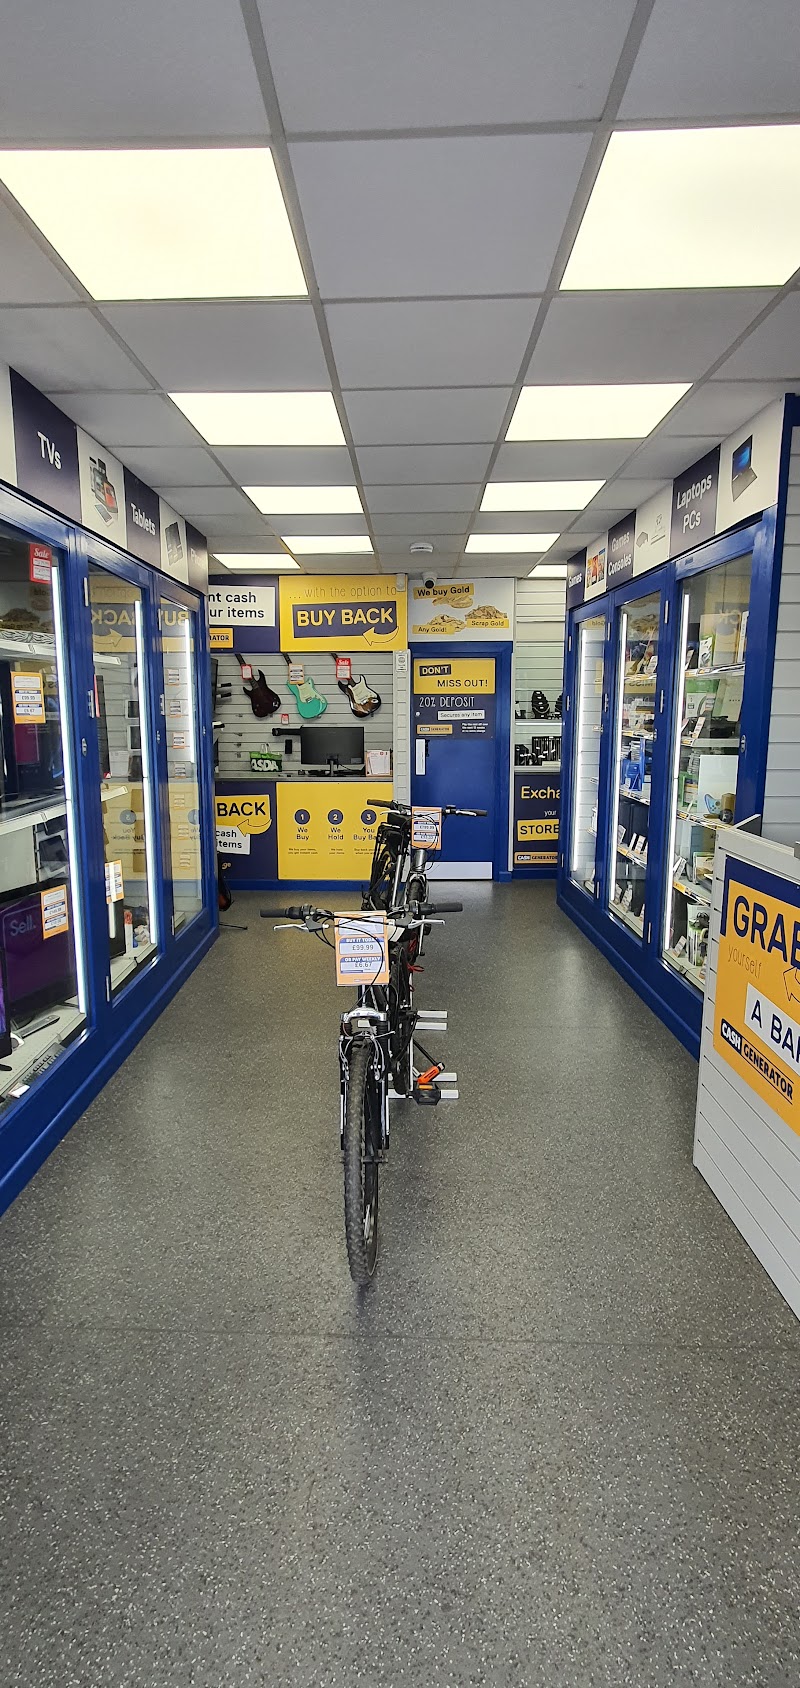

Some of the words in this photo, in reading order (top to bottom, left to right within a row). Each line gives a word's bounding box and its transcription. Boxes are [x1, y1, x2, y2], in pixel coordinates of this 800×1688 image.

[37, 431, 62, 470] TVs
[676, 474, 712, 510] Laptops
[130, 502, 156, 536] Tablets
[682, 509, 701, 534] PCs
[611, 531, 630, 552] Games
[33, 547, 50, 559] Sale
[607, 553, 632, 576] Consoles
[568, 572, 583, 588] Games
[225, 591, 257, 603] cash
[304, 587, 326, 598] with
[330, 586, 346, 597] the
[350, 585, 382, 599] option
[386, 586, 397, 596] to
[417, 589, 431, 597] We
[432, 588, 448, 597] buy
[450, 585, 470, 594] Gold
[227, 606, 265, 618] items
[296, 609, 336, 627] BUY
[341, 607, 393, 625] BACK
[471, 620, 489, 628] Scrap
[421, 665, 449, 675] DON'T
[437, 679, 461, 687] MISS
[463, 679, 488, 687] OUT!
[419, 696, 436, 708] 20%
[440, 696, 475, 708] DEPOSIT
[250, 759, 280, 772] ASDA
[216, 801, 266, 817] BACK
[332, 813, 339, 821] 2
[366, 813, 372, 821] 3
[10, 914, 37, 937] Sell.
[727, 944, 762, 980] yourself
[751, 999, 763, 1029] A
[721, 1022, 741, 1051] CASH
[743, 1043, 794, 1101] GENERATOR
